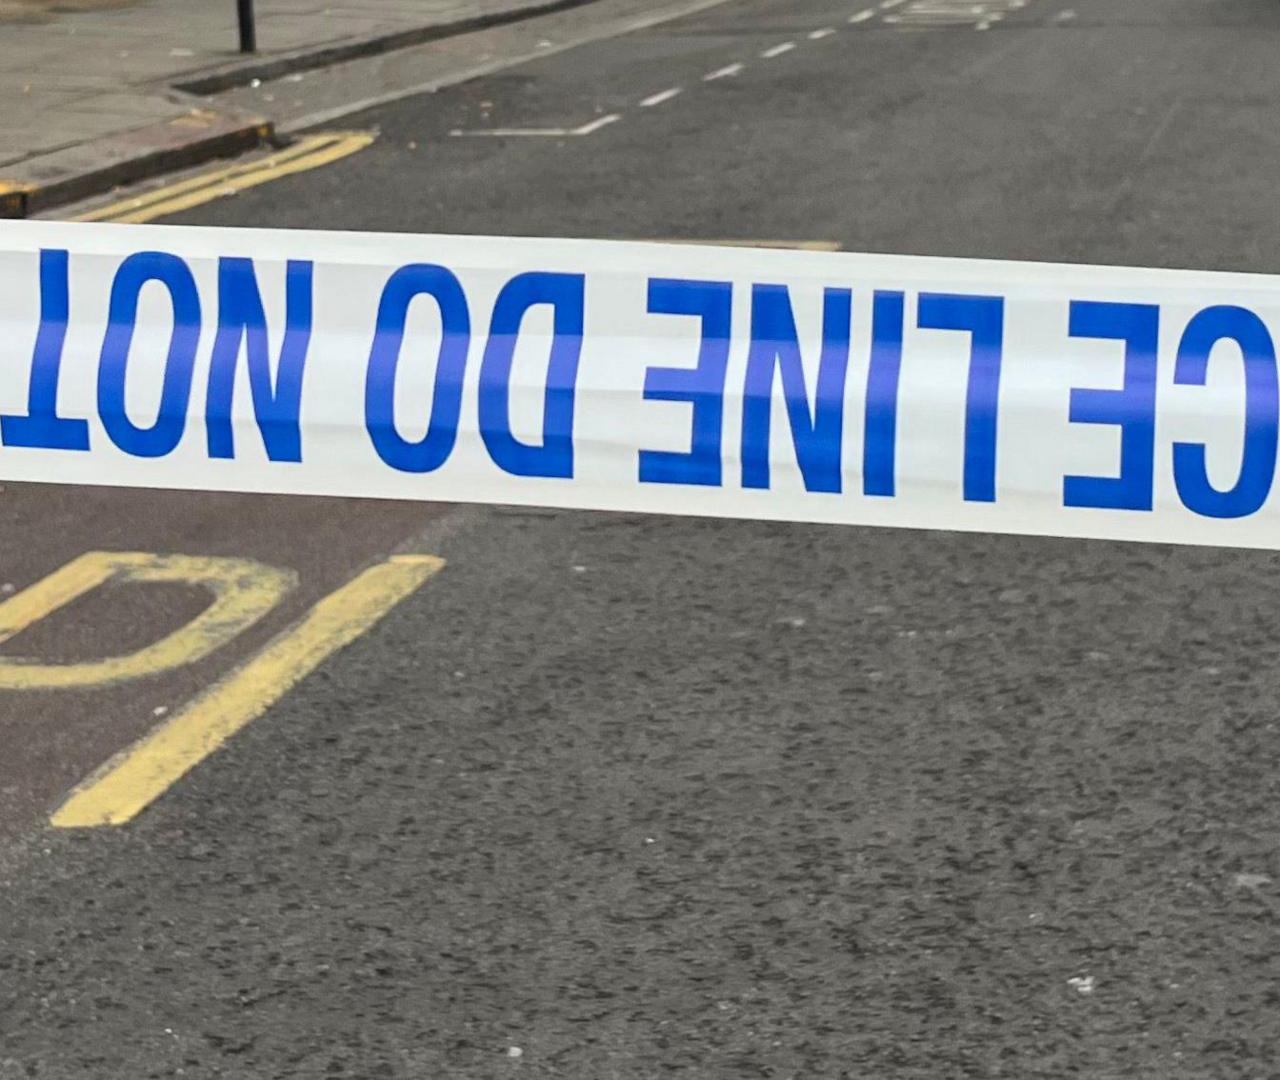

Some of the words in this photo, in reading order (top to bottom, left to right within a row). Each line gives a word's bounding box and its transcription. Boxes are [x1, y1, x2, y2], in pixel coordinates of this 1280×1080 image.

[0, 249, 313, 463] NOT
[365, 263, 585, 479] DO
[639, 278, 1005, 503] LINE
